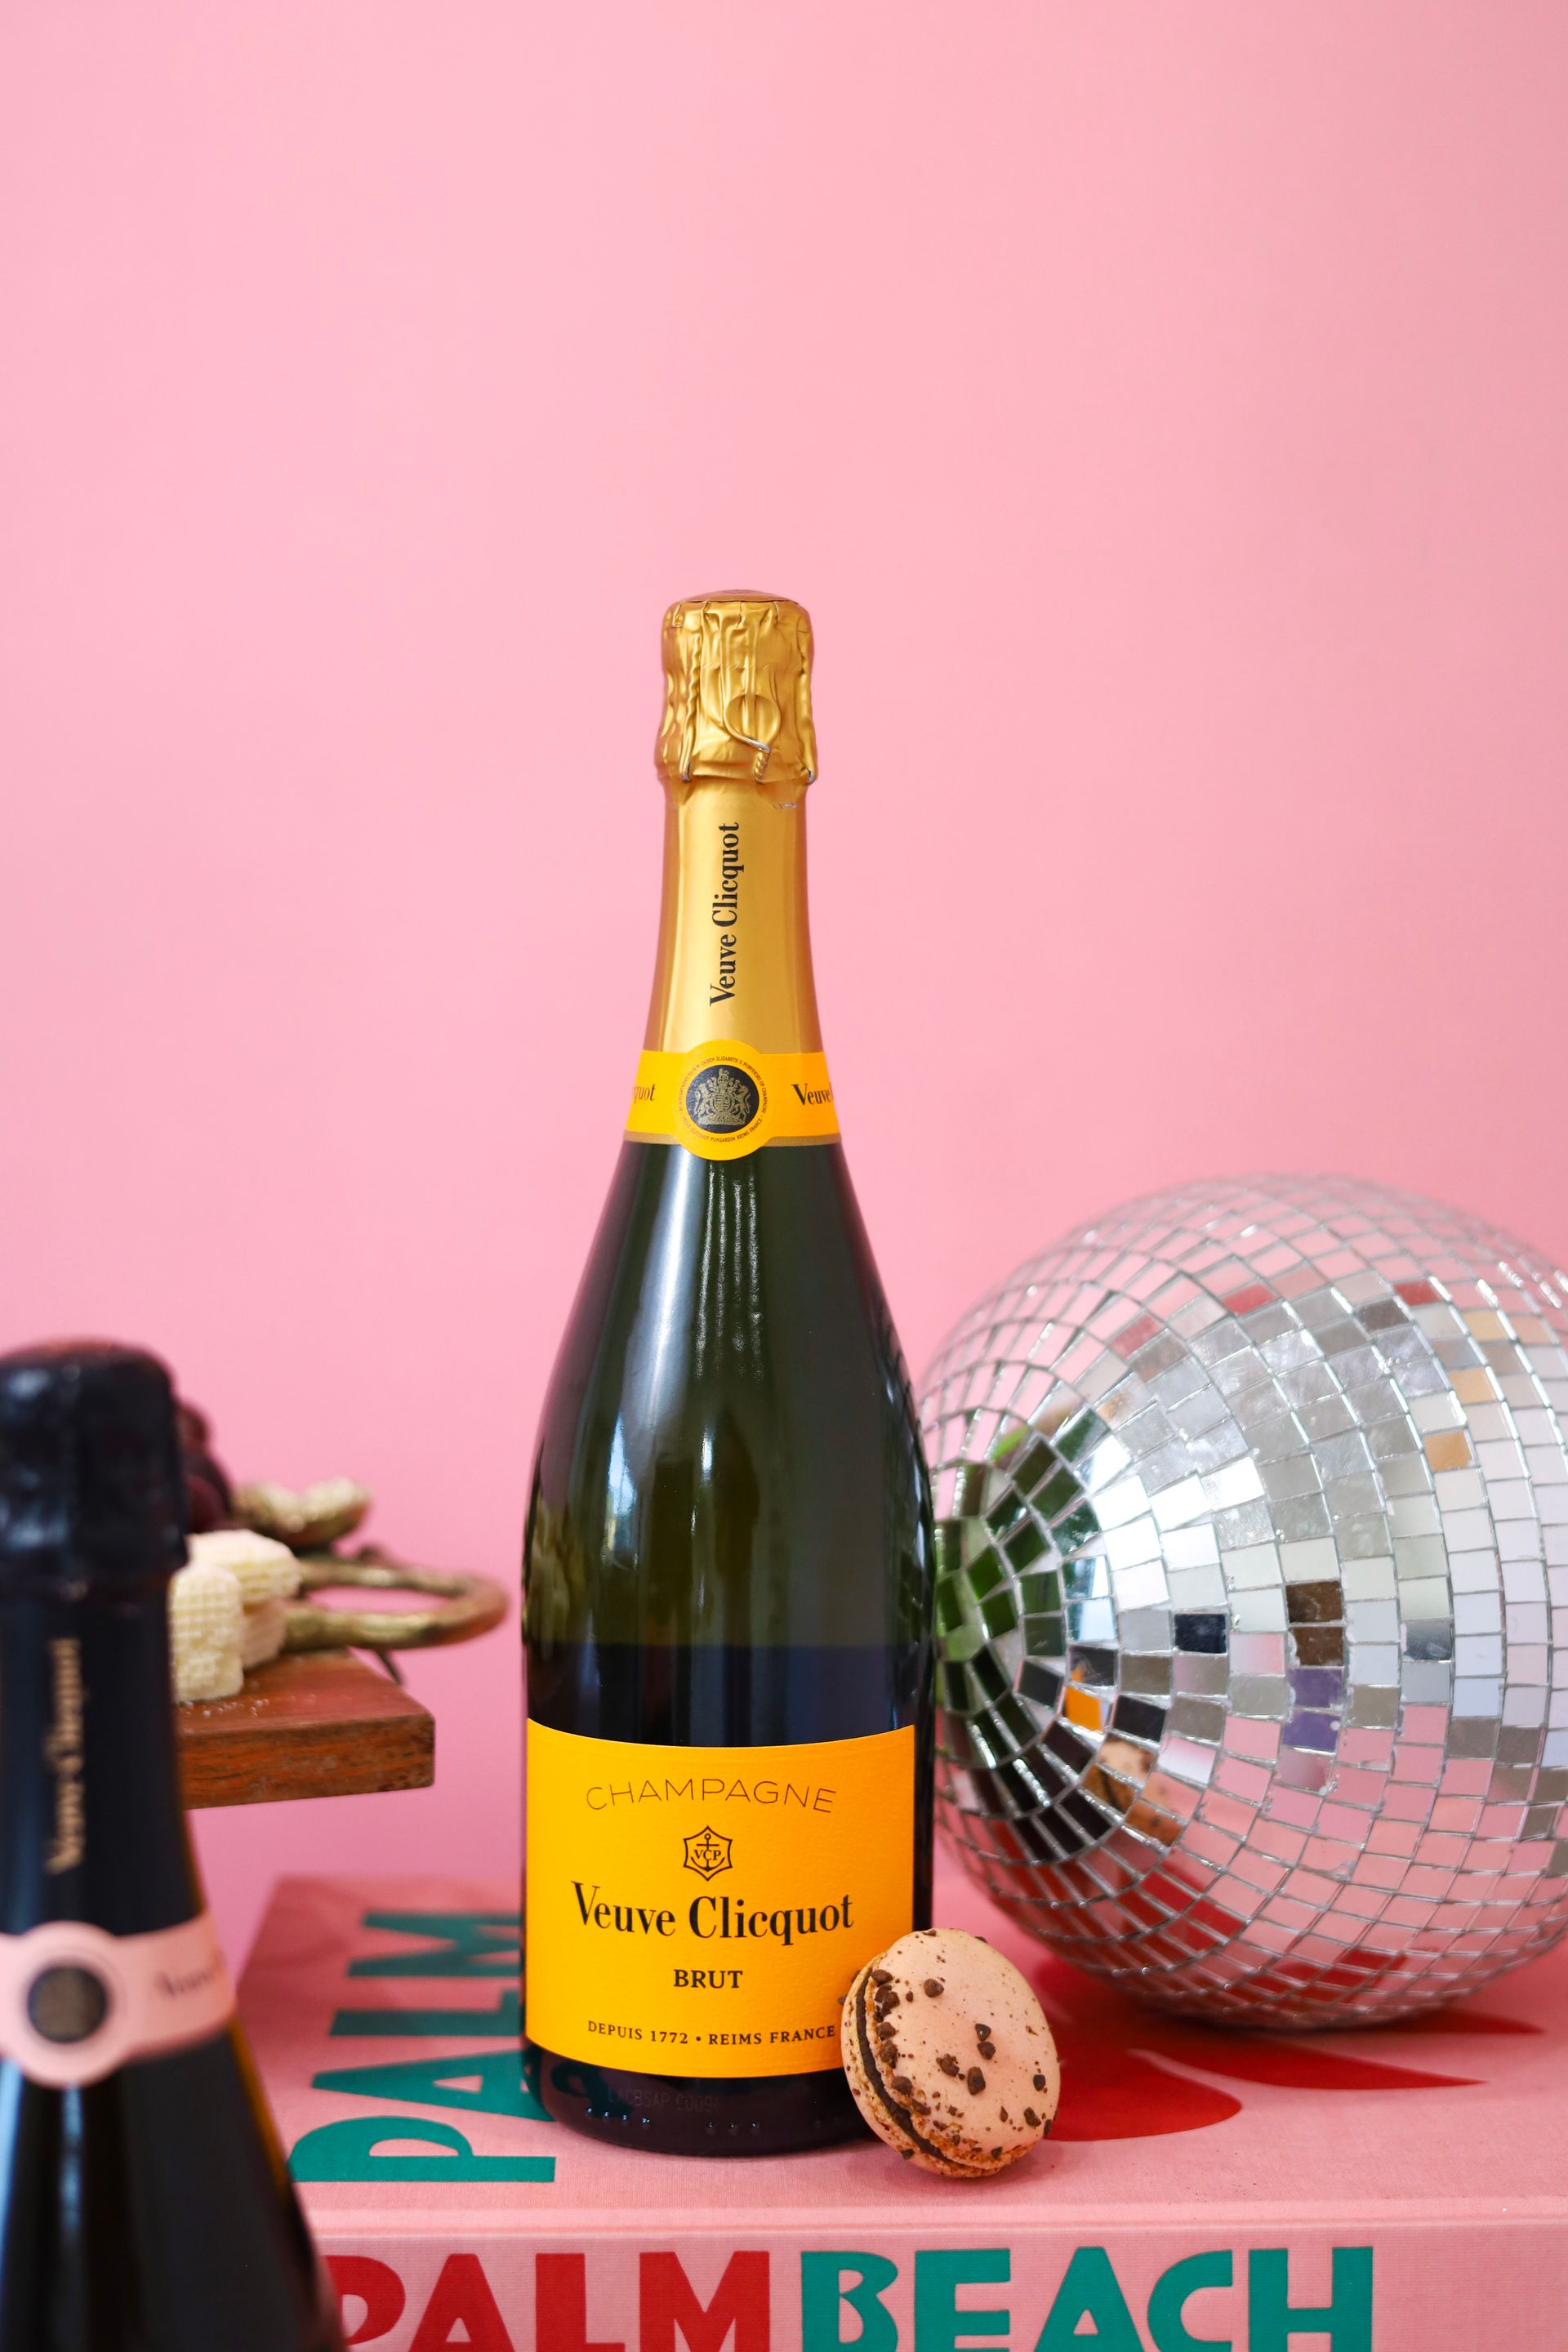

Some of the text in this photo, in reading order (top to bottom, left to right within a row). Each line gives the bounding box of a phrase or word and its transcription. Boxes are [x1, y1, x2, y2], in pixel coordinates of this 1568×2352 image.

[710, 822, 745, 1007] Veuve Clicquot
[791, 1083, 831, 1106] Veuve
[586, 1778, 836, 1814] CHAMPAGNE
[693, 1849, 722, 1861] VCP
[571, 1881, 854, 1946] Veuve Clicquot
[673, 1968, 744, 1989] BRUT
[588, 2020, 835, 2046] DEPUIS 1772 REIMS FRANCE
[800, 2246, 1374, 2352] BEACH
